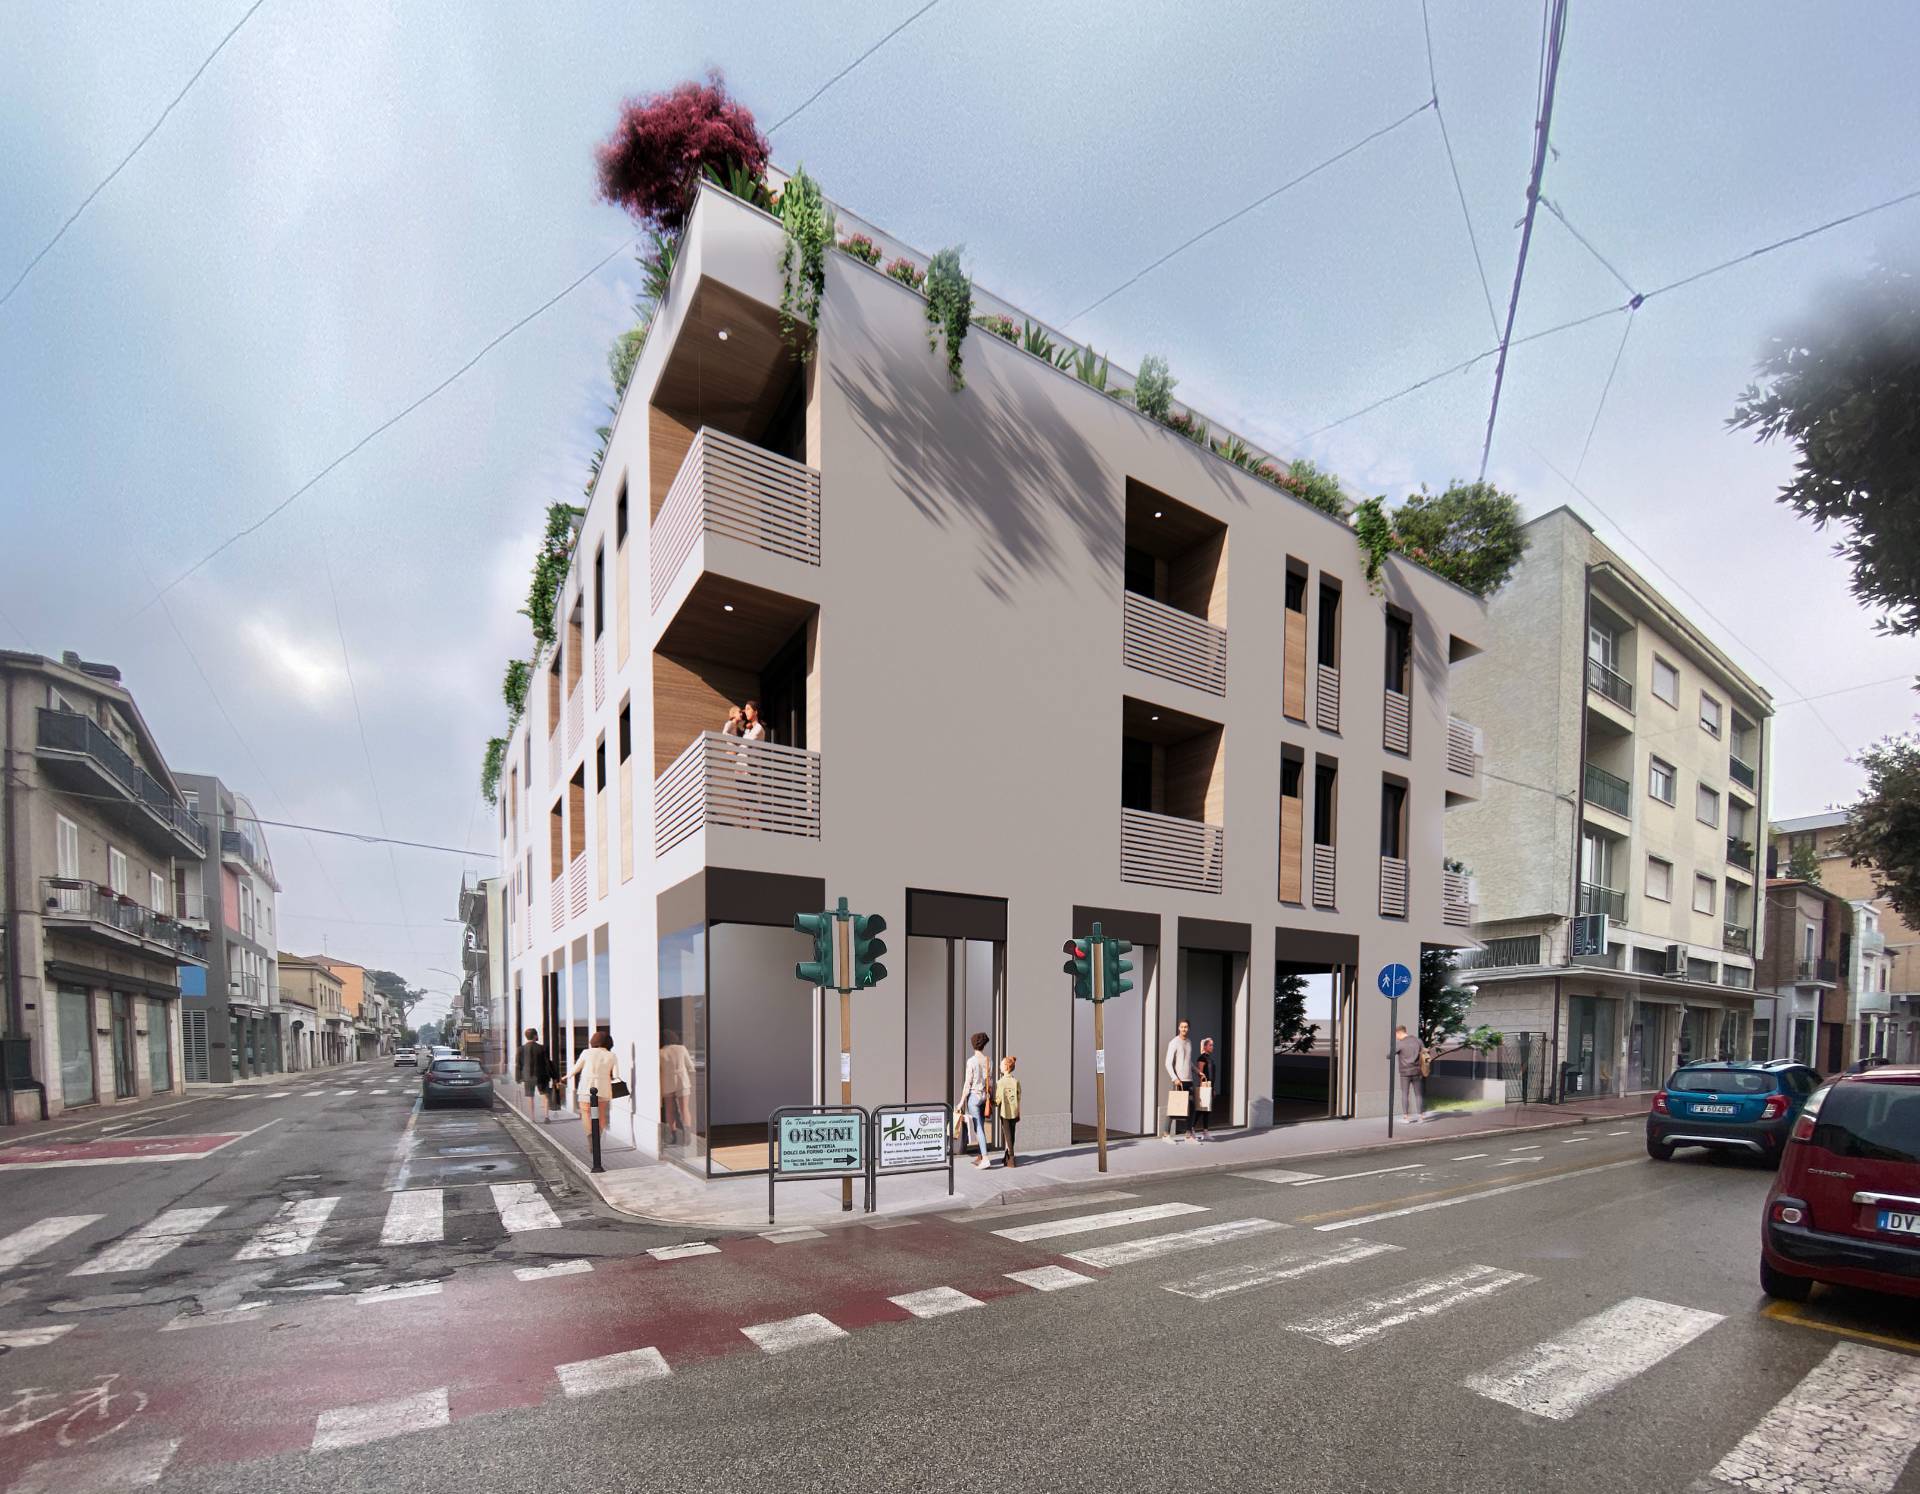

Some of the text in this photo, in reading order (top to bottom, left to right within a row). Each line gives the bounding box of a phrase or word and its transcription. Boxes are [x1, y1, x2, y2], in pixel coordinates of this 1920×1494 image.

[788, 1126, 853, 1143] ORSINI
[900, 1127, 942, 1140] Del Vomano
[1890, 1213, 1915, 1231] DV
